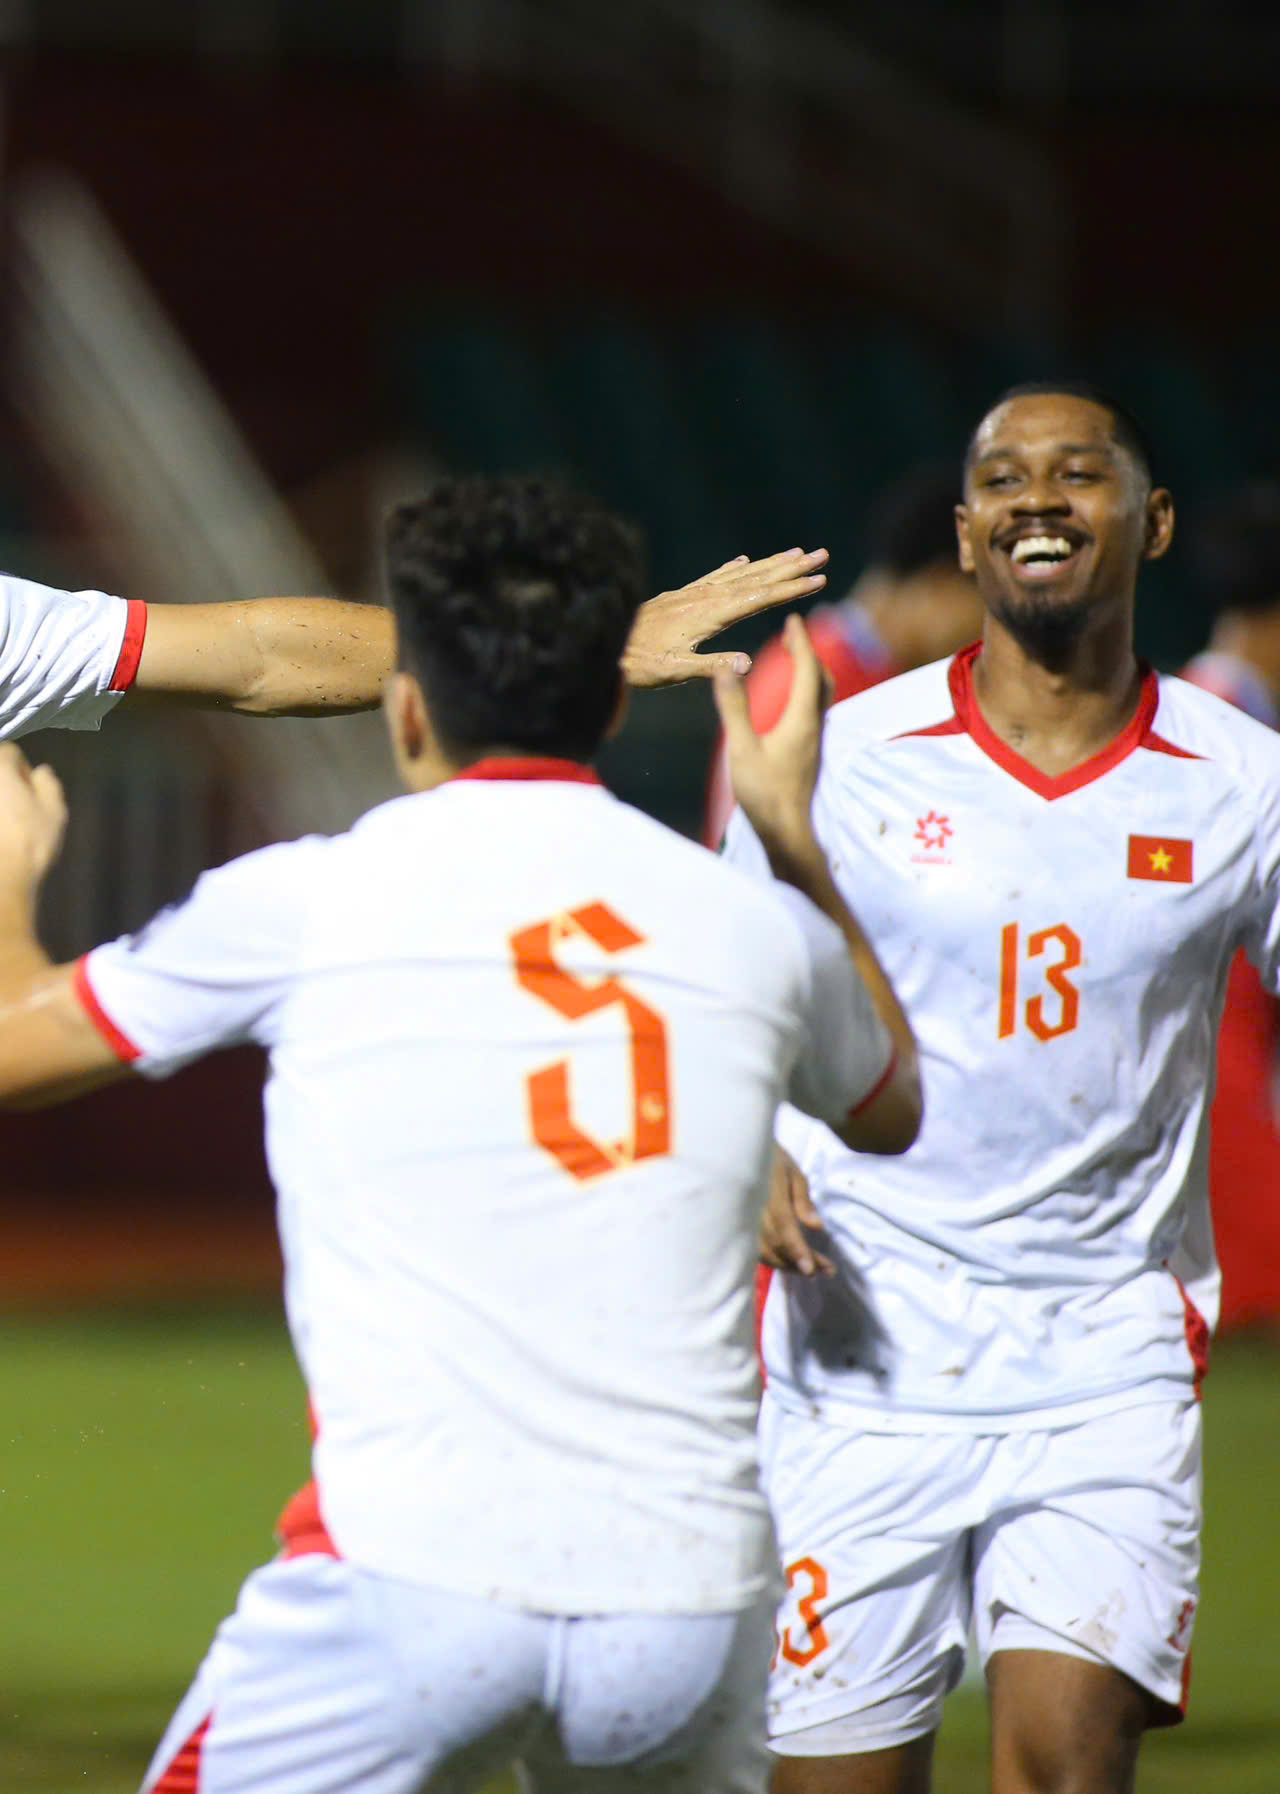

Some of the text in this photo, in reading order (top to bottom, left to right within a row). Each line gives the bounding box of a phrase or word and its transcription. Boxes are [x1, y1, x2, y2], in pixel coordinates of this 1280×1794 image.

[998, 922, 1082, 1041] 13
[508, 900, 672, 1185] 5
[772, 1556, 828, 1667] 3
